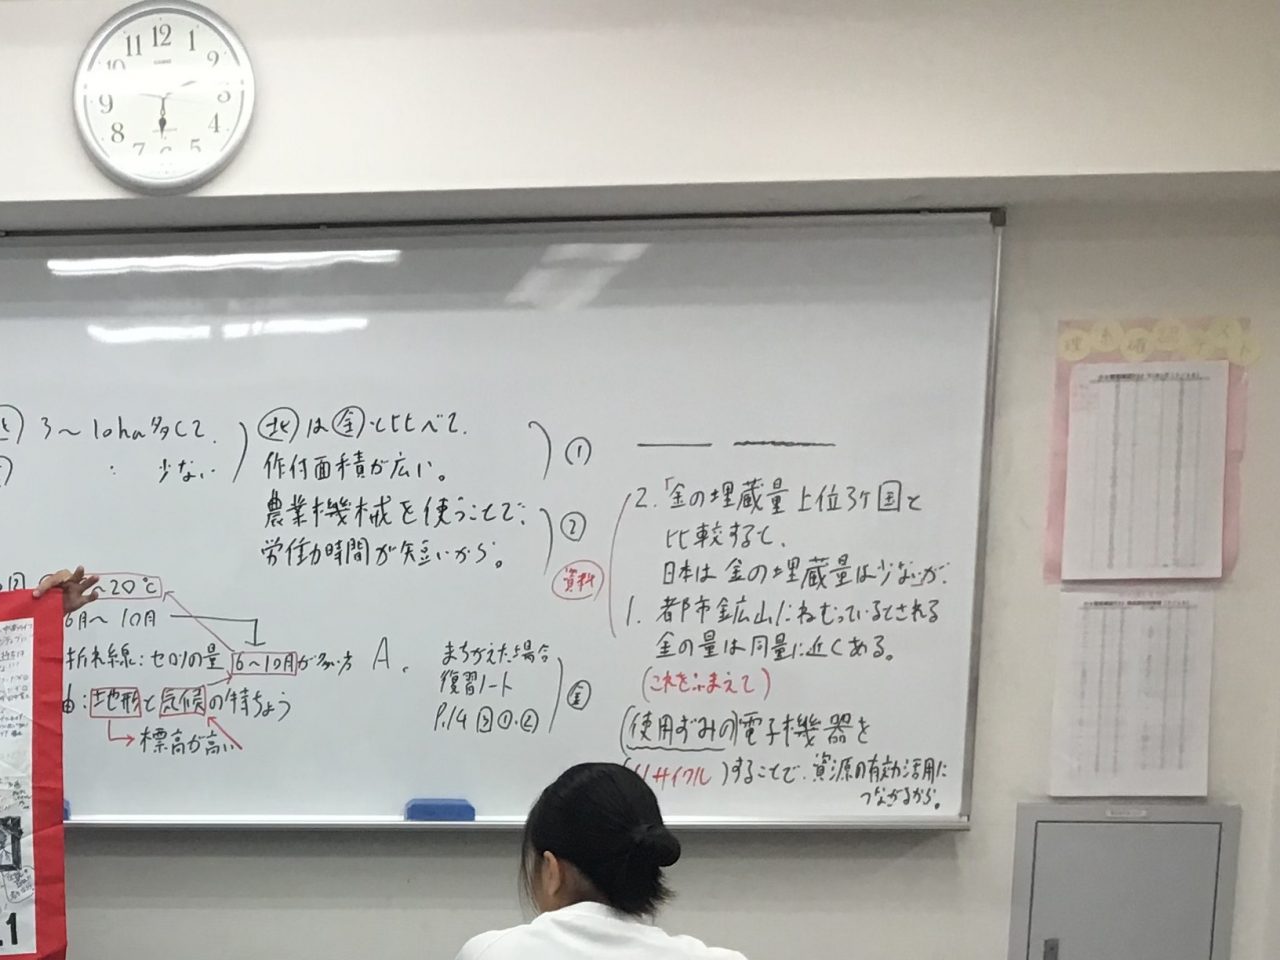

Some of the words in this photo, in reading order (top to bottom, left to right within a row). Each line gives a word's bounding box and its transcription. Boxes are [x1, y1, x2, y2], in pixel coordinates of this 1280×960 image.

[125, 33, 143, 57] 11
[152, 23, 172, 48] 12
[188, 28, 196, 52] 1
[98, 94, 114, 115] 9
[110, 121, 125, 144] 8
[207, 111, 221, 134] 4
